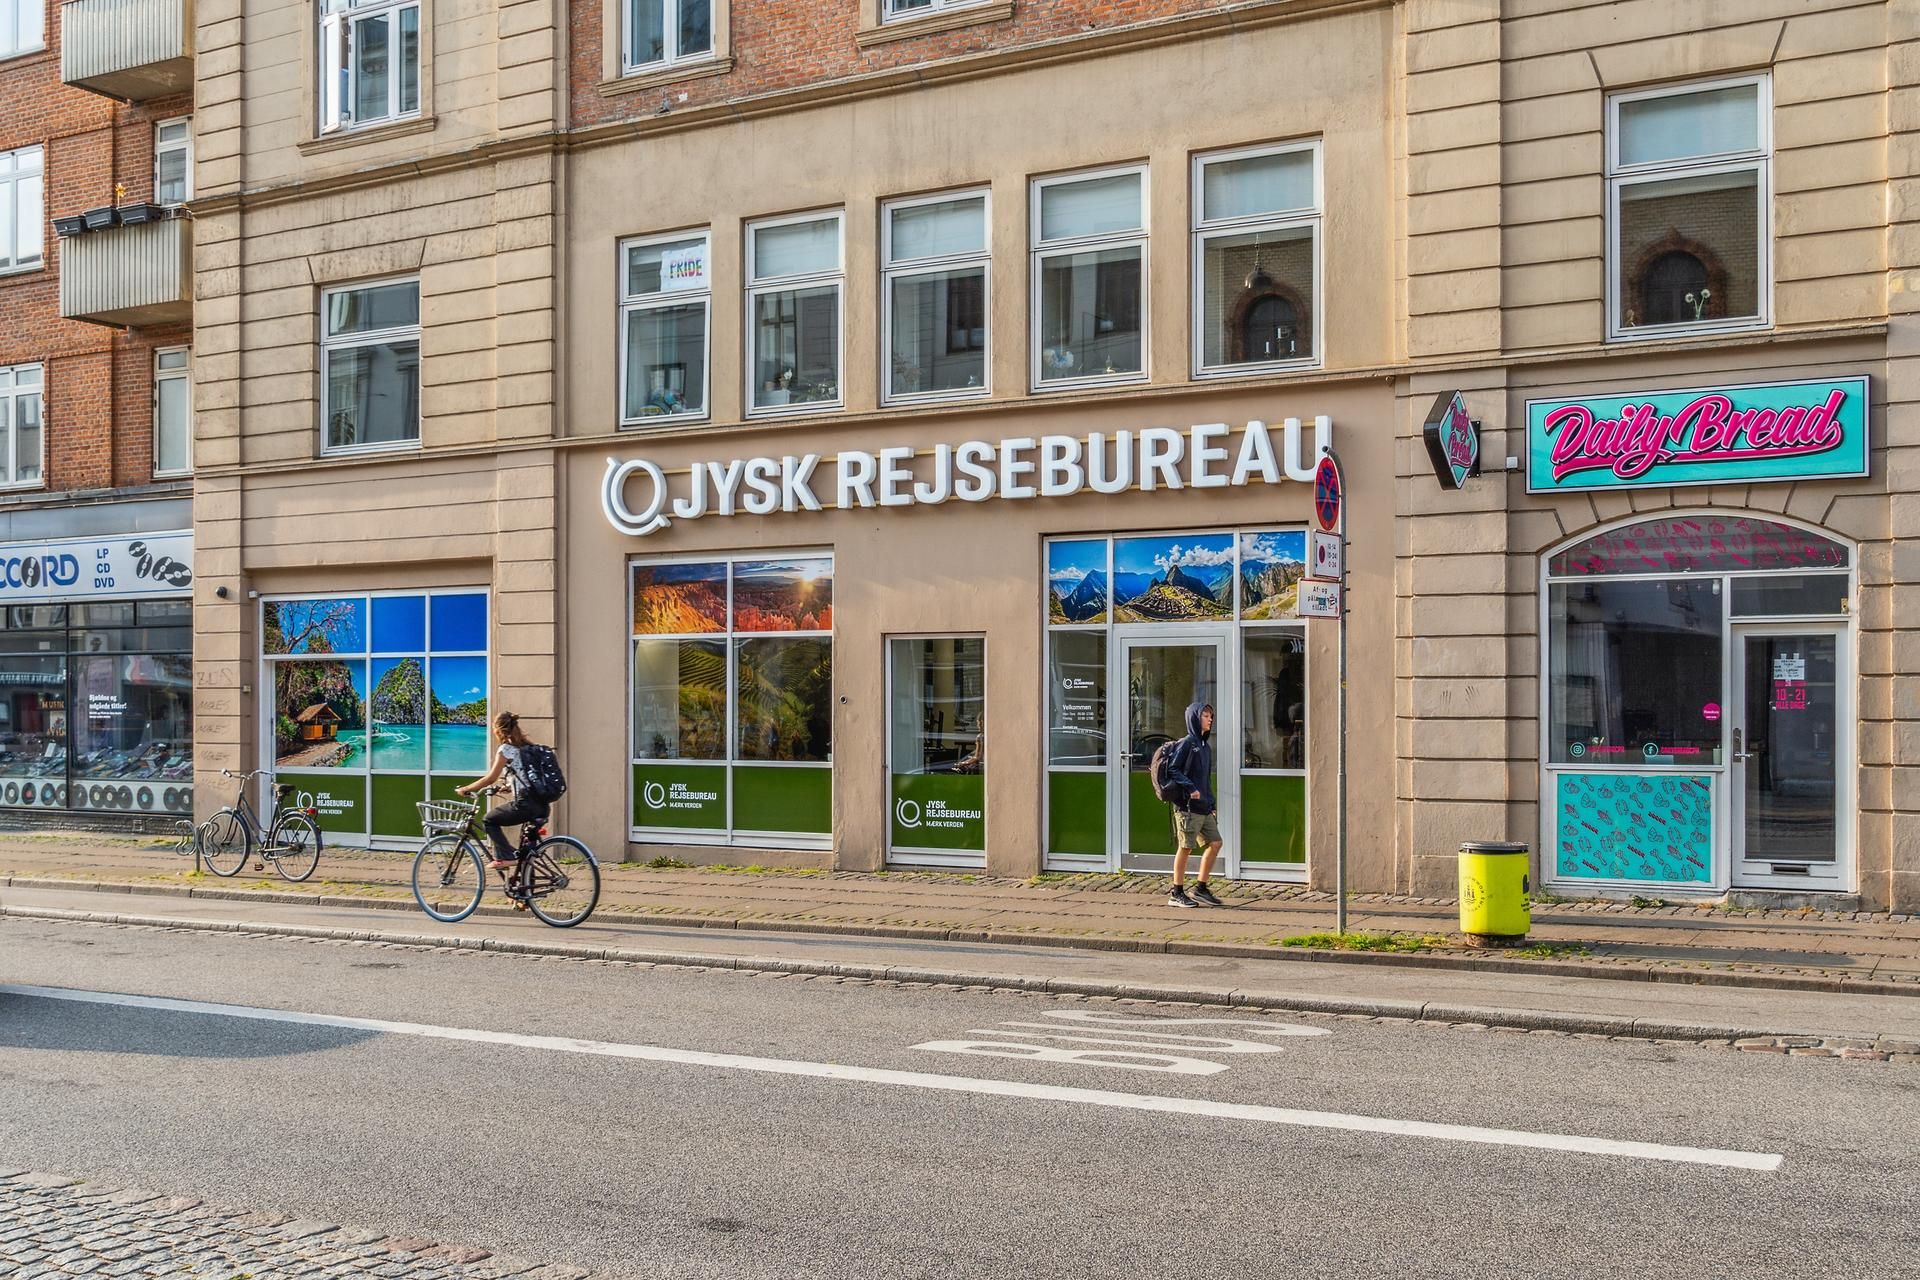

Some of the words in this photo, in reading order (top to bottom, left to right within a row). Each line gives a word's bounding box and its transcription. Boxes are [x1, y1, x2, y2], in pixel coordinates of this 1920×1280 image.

[670, 258, 703, 279] PRIDE
[1544, 403, 1675, 478] Daily
[1670, 389, 1847, 454] Bread
[673, 454, 823, 519] JYSK
[837, 415, 1333, 509] REJSEBUREAU
[96, 548, 109, 559] LP
[96, 563, 111, 573] CD
[94, 577, 115, 588] DVD
[669, 783, 688, 791] JYSK
[669, 792, 717, 801] REJSEBUREAU
[925, 800, 946, 809] JYSK
[925, 809, 981, 819] REJSEBUREAU
